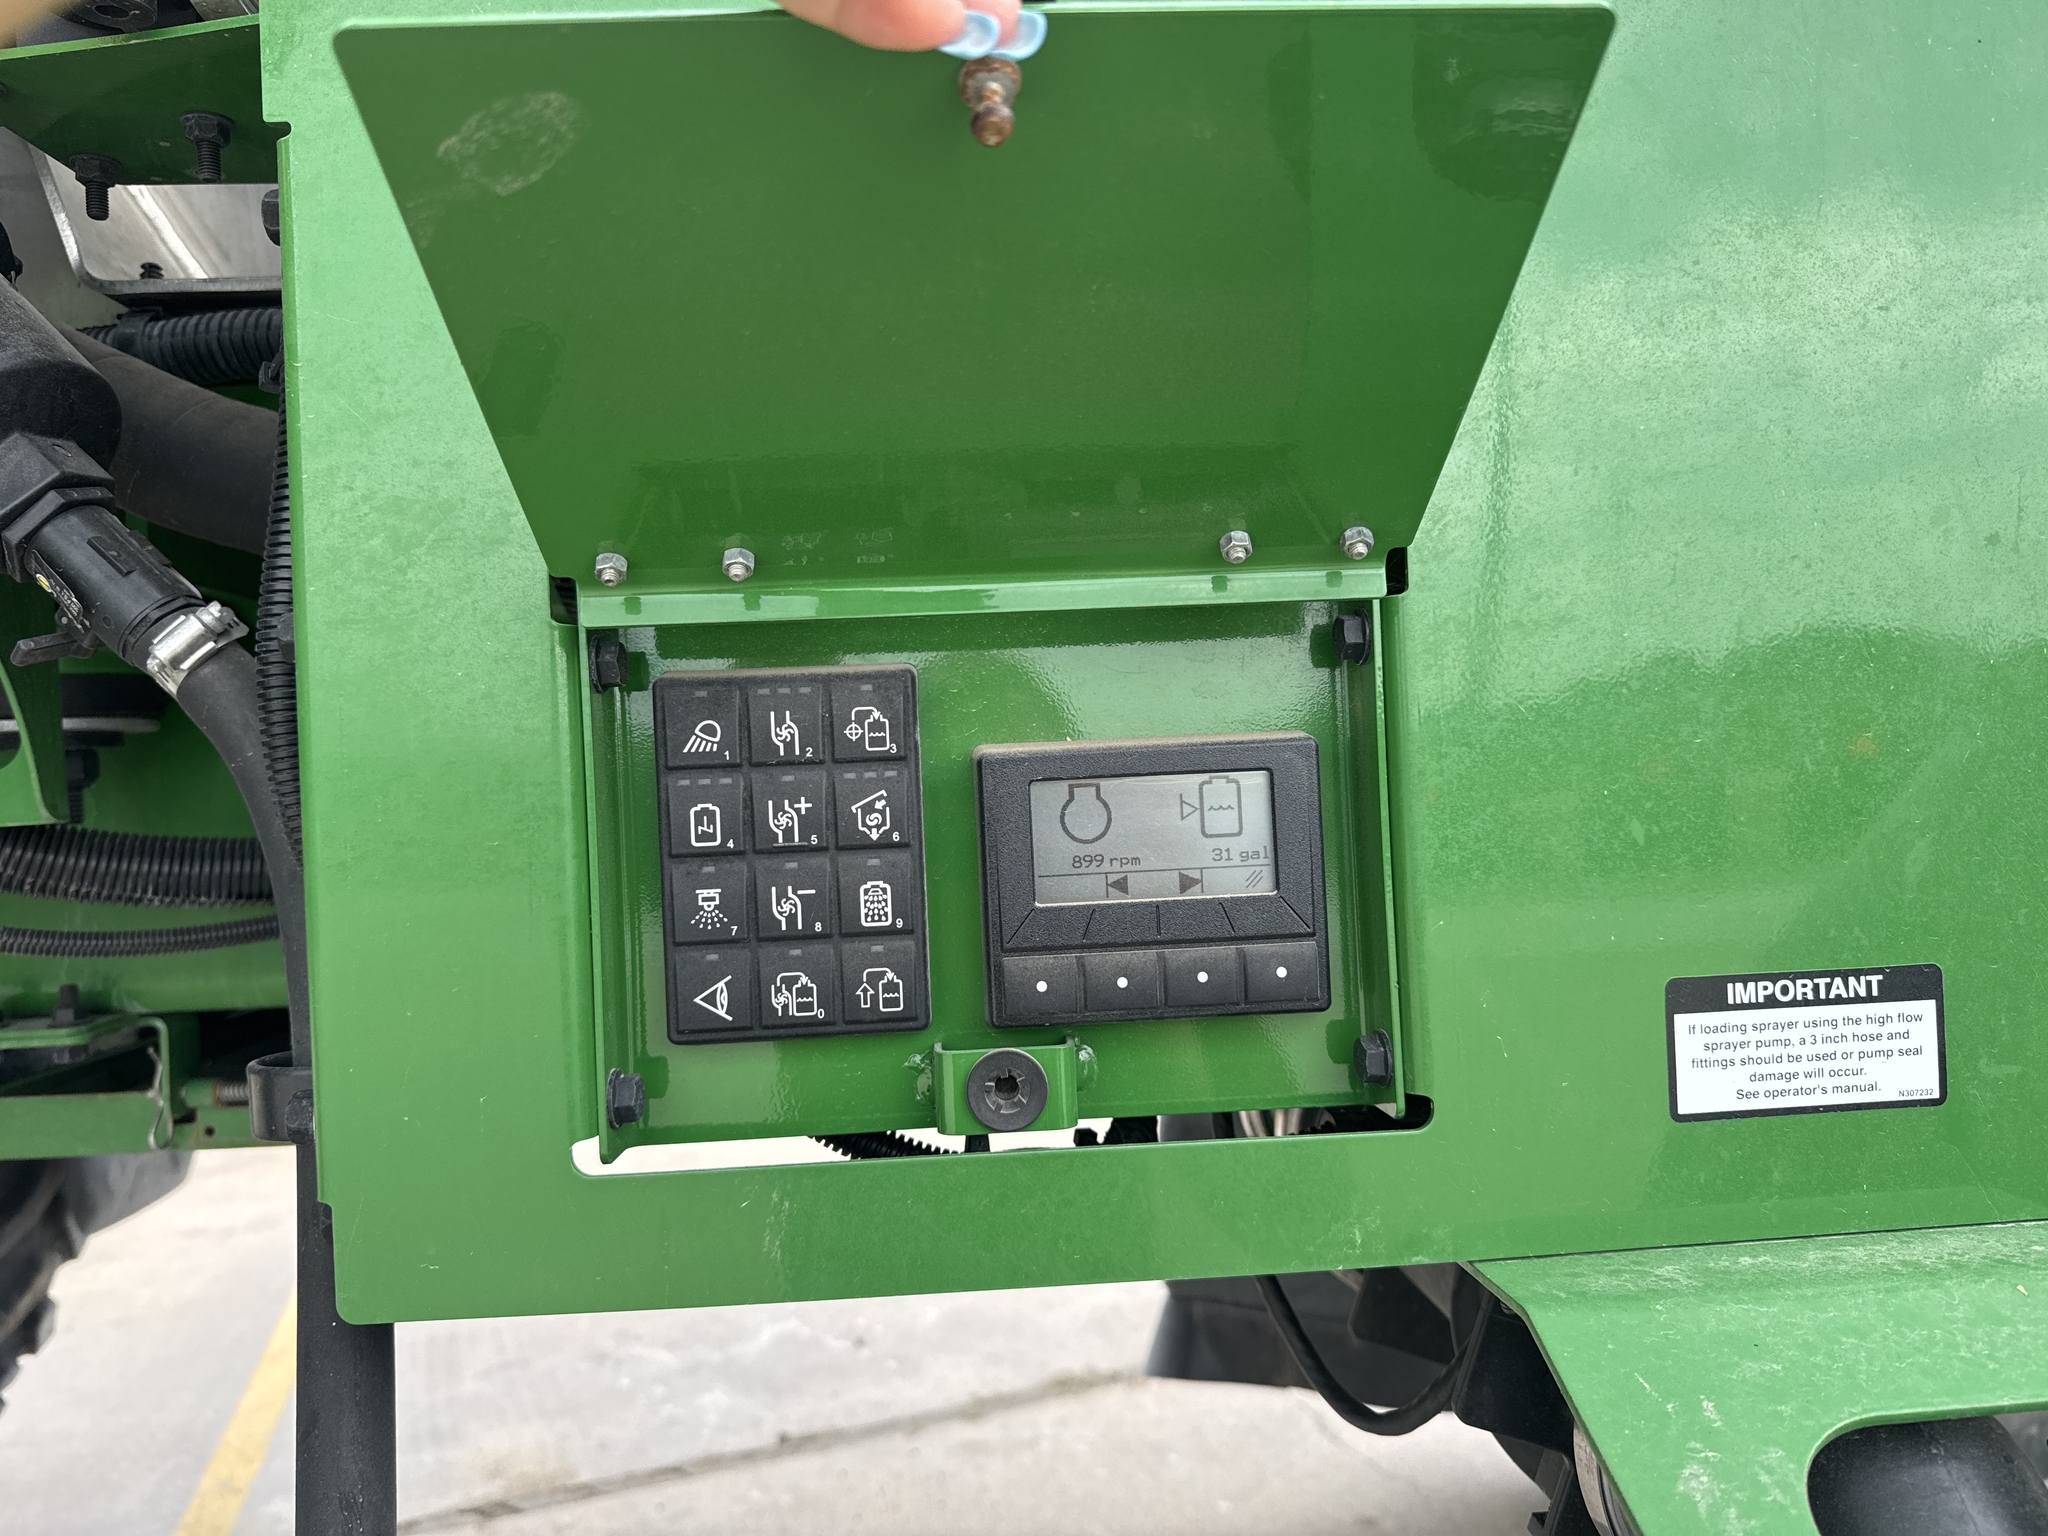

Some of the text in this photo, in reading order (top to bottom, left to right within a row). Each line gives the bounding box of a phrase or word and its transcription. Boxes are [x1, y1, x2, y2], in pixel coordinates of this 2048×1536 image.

[804, 746, 814, 759] 2
[888, 742, 898, 754] 3
[723, 750, 730, 761] 1
[810, 834, 819, 845] 5
[892, 831, 901, 842] 6
[726, 838, 735, 850] 4
[1211, 846, 1270, 862] 31 gal
[1071, 855, 1141, 869] 899 rpm
[814, 921, 823, 933] 8
[895, 917, 904, 929] 9
[730, 925, 738, 937] 7
[1726, 974, 1884, 1005] IMPORTANT
[817, 1008, 825, 1020] 0
[1688, 1012, 1923, 1035] If loading sprayer using the high flow
[1703, 1029, 1910, 1054] sprayer pump, a 3 inch hose and
[1691, 1045, 1923, 1070] fittings should be used or pump seal
[1749, 1067, 1867, 1083] damage will occur.
[1736, 1081, 1881, 1101] See operator's manual.
[1898, 1087, 1935, 1098] N307232
